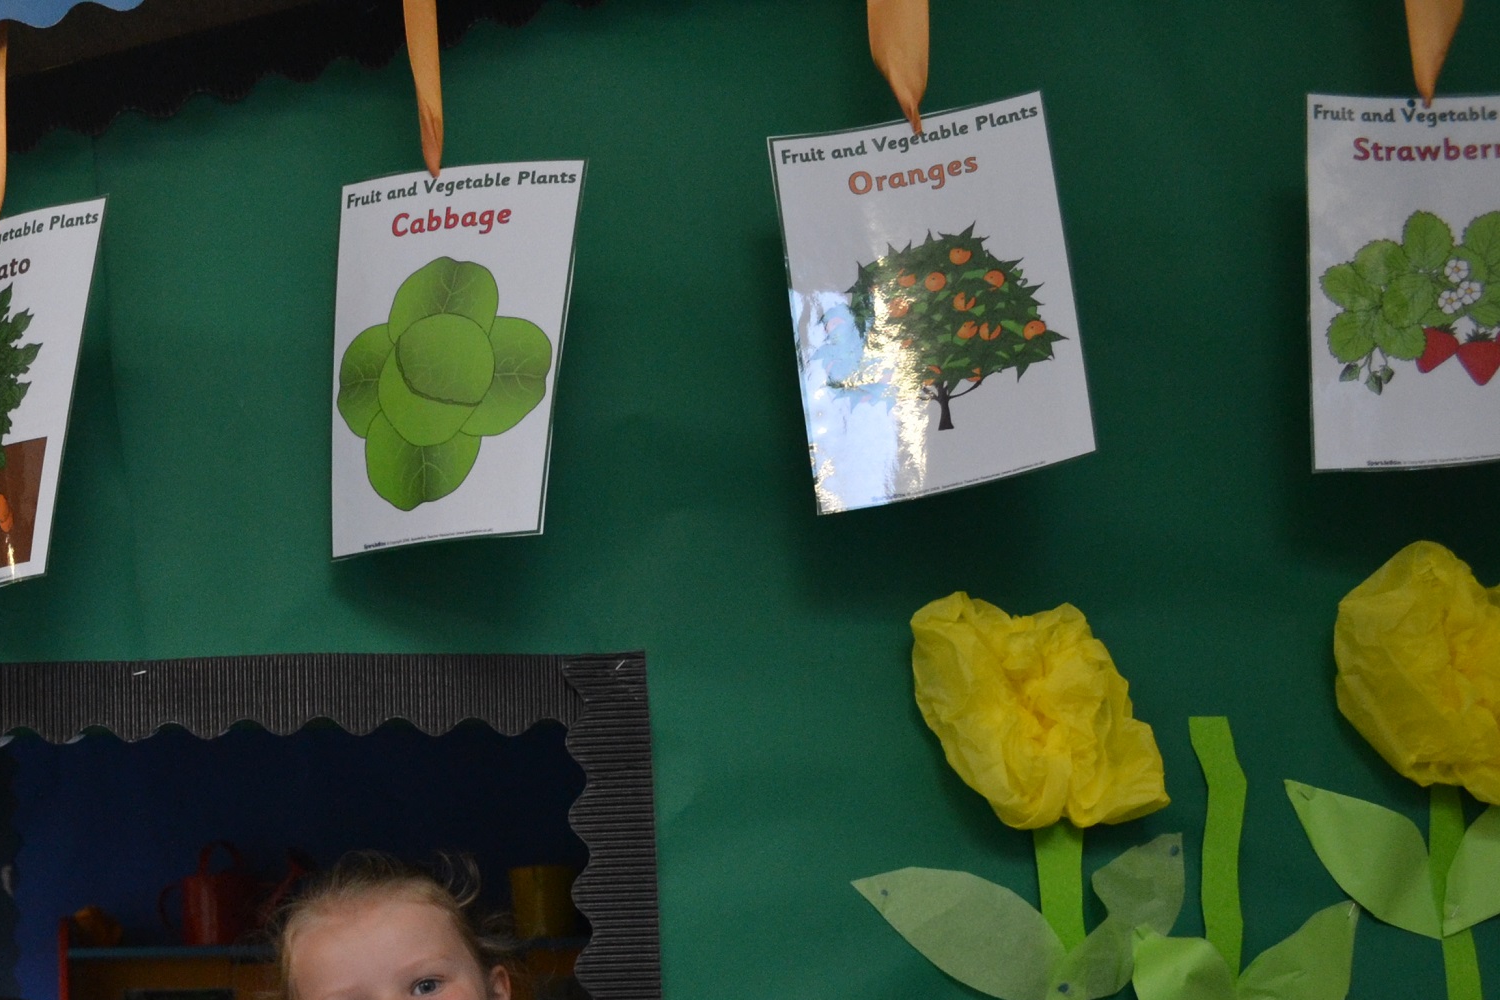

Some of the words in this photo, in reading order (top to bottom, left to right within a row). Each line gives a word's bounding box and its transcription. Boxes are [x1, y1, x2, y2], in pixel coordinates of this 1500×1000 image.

[1313, 104, 1355, 121] Fruit
[1361, 107, 1396, 123] and
[1401, 106, 1497, 128] Vegetable
[781, 148, 825, 165] Fruit
[831, 140, 867, 160] and
[871, 121, 969, 153] Vegetable
[975, 105, 1038, 132] Plants
[346, 190, 382, 209] Fruit
[387, 180, 418, 200] and
[424, 173, 511, 197] Vegetable
[517, 170, 576, 186] Plants
[848, 155, 979, 195] Oranges
[49, 212, 99, 230] Plants
[391, 207, 512, 237] Cabbage
